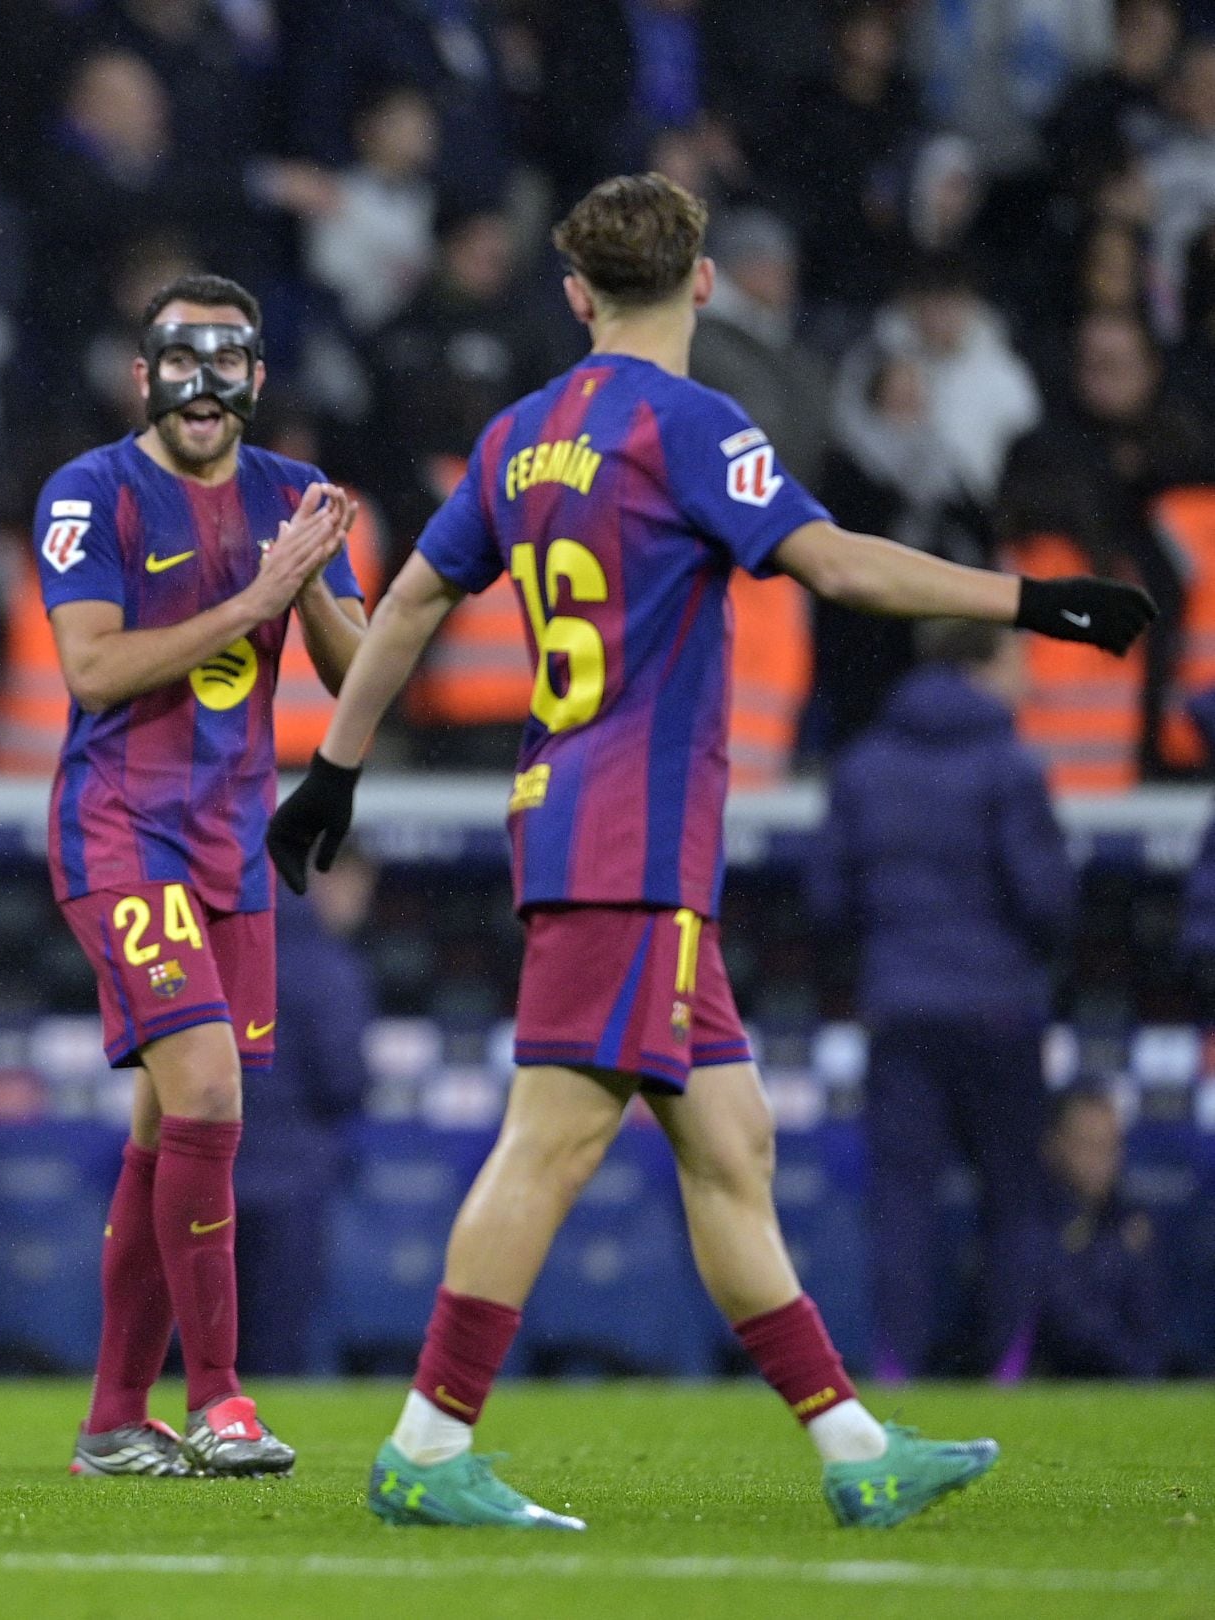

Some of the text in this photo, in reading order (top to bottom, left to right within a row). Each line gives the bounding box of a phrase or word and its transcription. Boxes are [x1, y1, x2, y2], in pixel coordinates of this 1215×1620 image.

[506, 432, 602, 501] FERMÍN
[511, 538, 608, 734] 16
[113, 884, 203, 966] 24
[673, 908, 702, 996] 1
